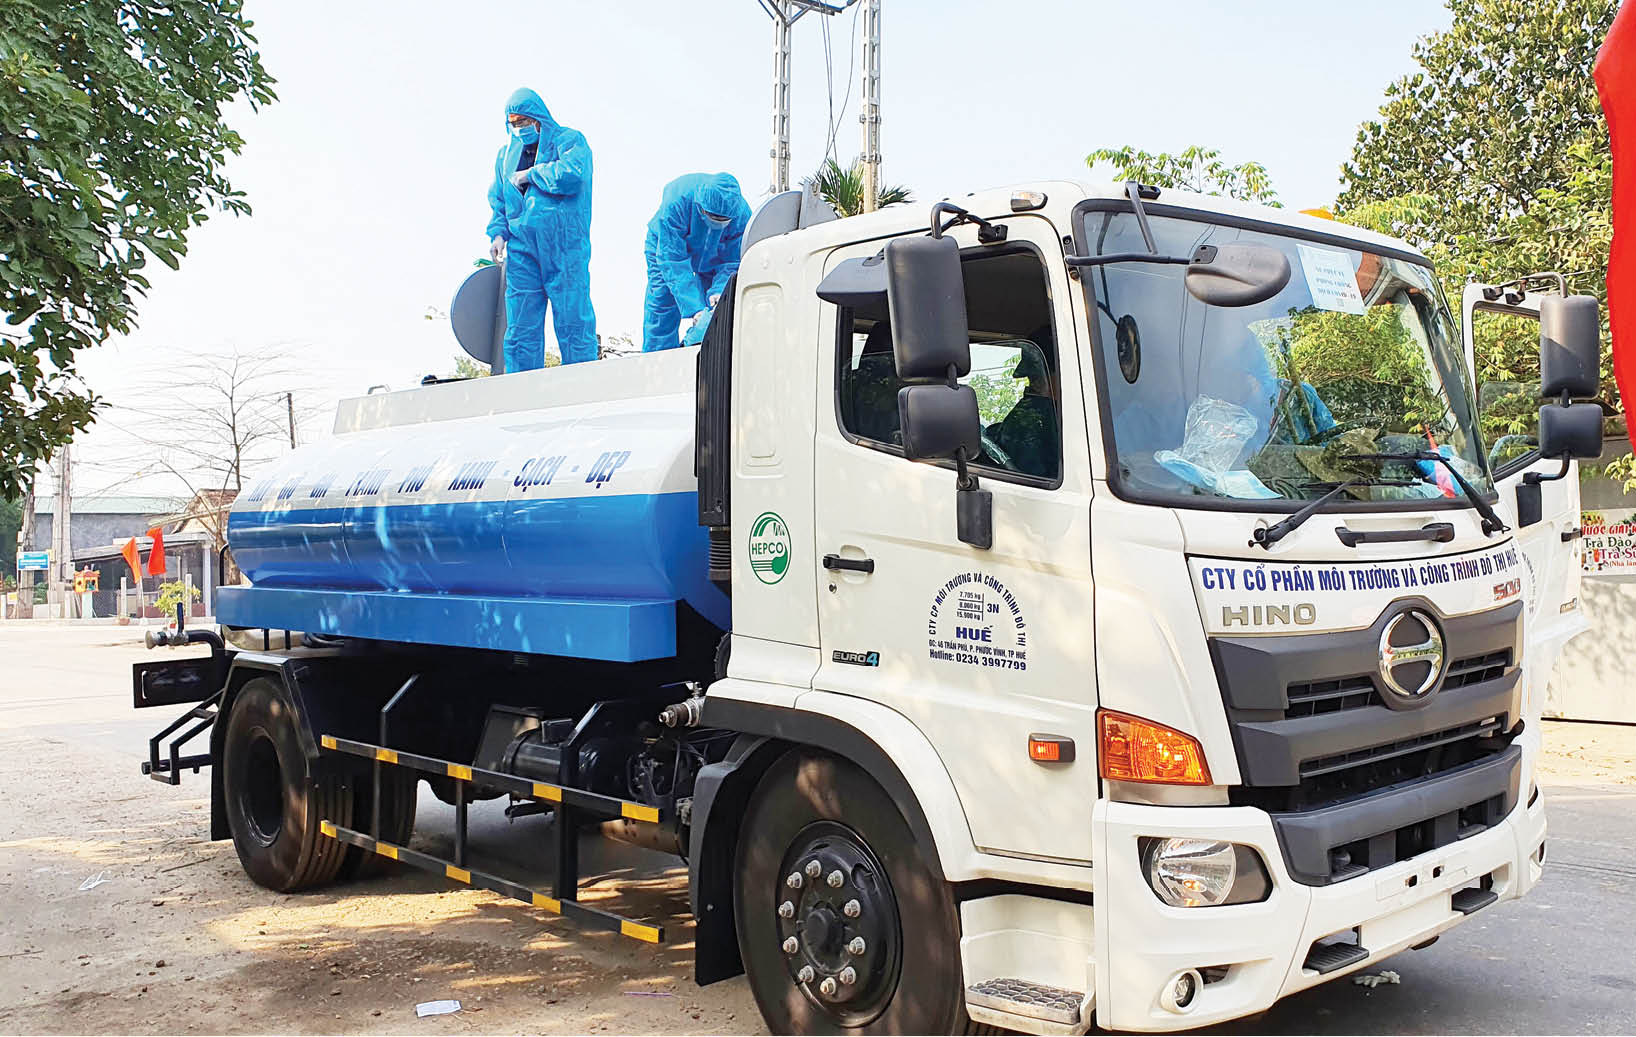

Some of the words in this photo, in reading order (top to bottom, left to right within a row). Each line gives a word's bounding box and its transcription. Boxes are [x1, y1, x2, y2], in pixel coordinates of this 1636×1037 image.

[513, 455, 568, 493] SẠCH
[751, 541, 784, 555] HEPCO
[973, 571, 983, 583] VÀ
[1201, 567, 1236, 590] CTY
[1243, 563, 1267, 592] CỔ
[1271, 565, 1315, 592] PHẦN
[1318, 566, 1347, 591] MÔI
[1349, 564, 1400, 591] TRƯỜNG
[1400, 563, 1419, 588] VÀ
[1419, 562, 1450, 586] CÔNG
[1450, 557, 1480, 582] TRÌNH
[1493, 551, 1508, 573] THỊ
[983, 575, 1004, 594] CÔNG
[935, 588, 948, 606] MÔI
[1002, 588, 1021, 616] TRÌNH
[930, 605, 939, 618] CP
[987, 603, 999, 614] 3N
[1222, 603, 1317, 627] HINO
[928, 619, 937, 635] CTY
[955, 625, 993, 643] HUẾ
[1015, 632, 1026, 646] THỊ
[833, 651, 878, 667] EURO4
[929, 649, 955, 662] Hotline:
[956, 652, 979, 665] 0234
[982, 656, 1026, 671] 3997799
